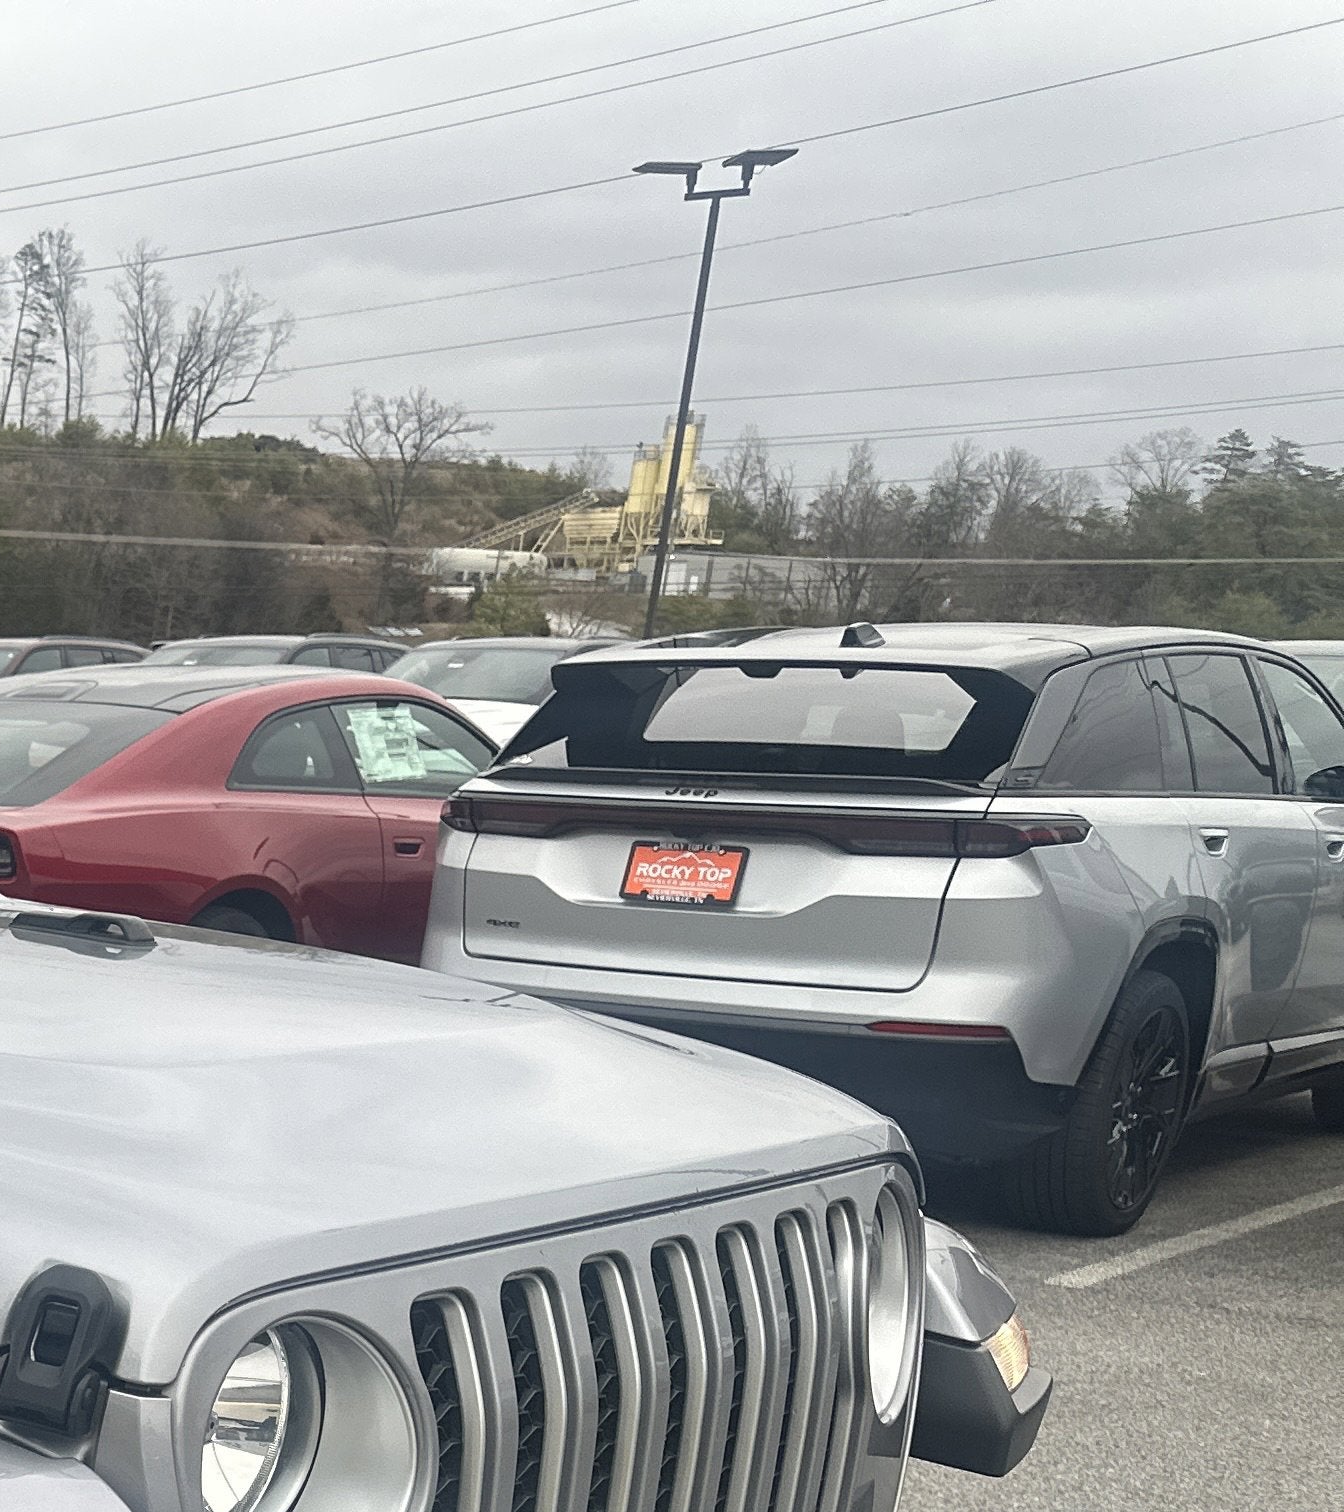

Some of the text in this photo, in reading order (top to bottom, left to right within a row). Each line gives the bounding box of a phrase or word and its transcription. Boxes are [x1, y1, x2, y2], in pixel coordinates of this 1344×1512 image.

[665, 787, 718, 798] Jeep
[636, 863, 732, 882] ROCKY TOP
